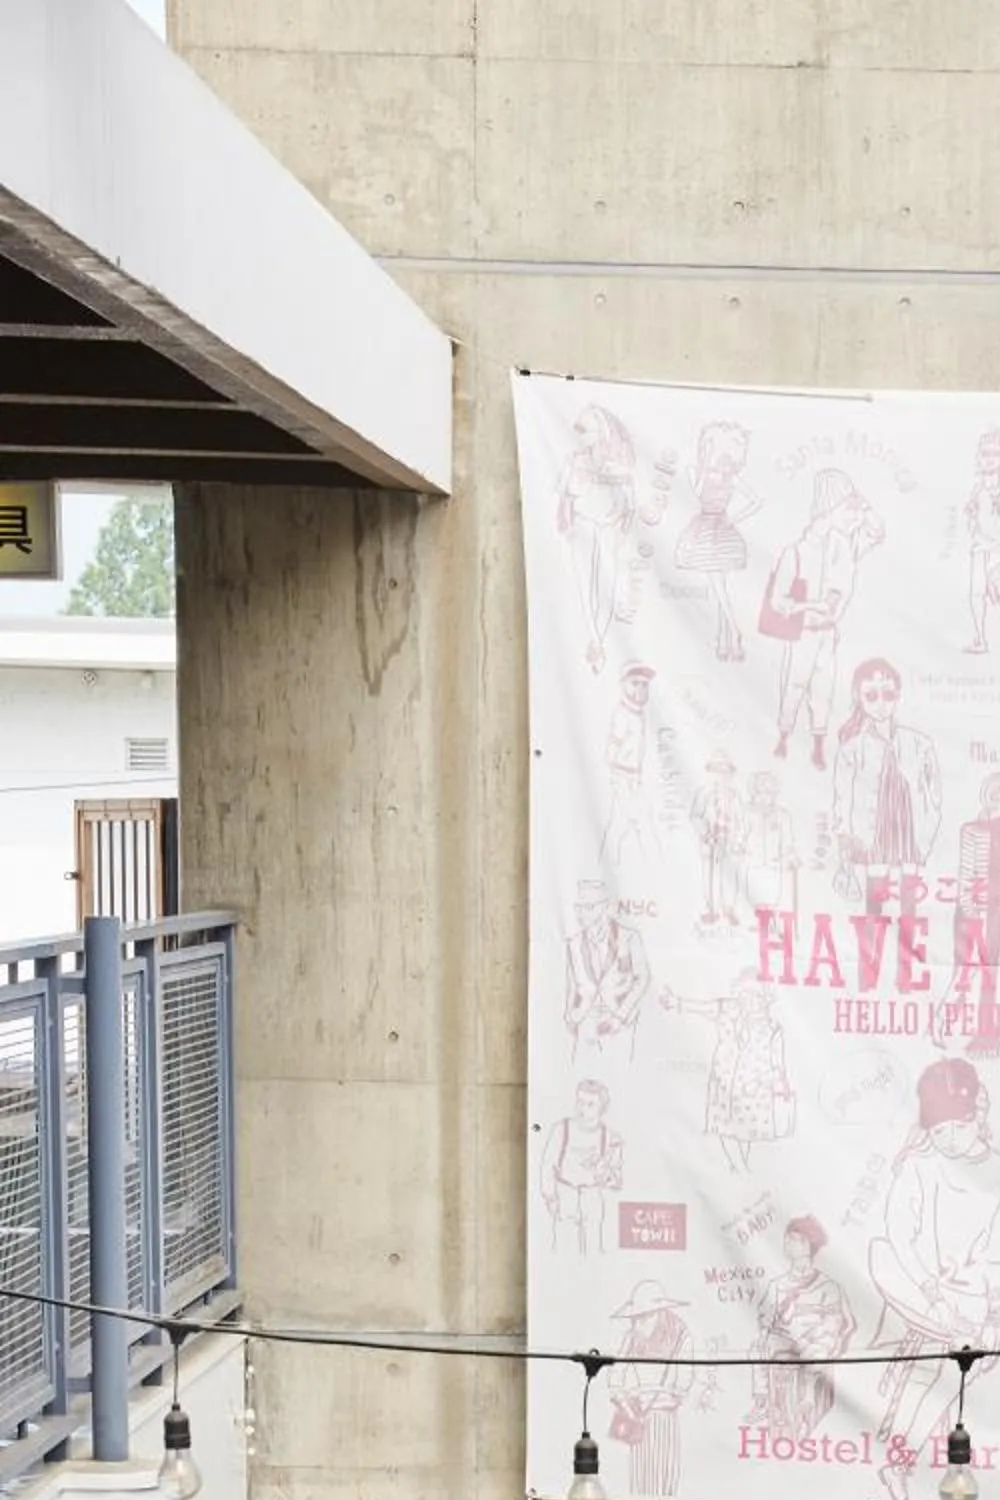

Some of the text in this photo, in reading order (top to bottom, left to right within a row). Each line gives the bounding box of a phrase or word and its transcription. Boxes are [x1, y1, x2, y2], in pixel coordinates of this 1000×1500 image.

[774, 431, 835, 480] Santa
[616, 900, 659, 919] NYC
[754, 906, 931, 994] HAVE
[954, 917, 998, 993] A
[630, 1226, 676, 1244] TOWN
[703, 1265, 766, 1286] Mexico
[717, 1284, 756, 1303] City
[737, 1425, 873, 1466] Hostel
[885, 1433, 917, 1468] &
[930, 1435, 1000, 1471] Br
